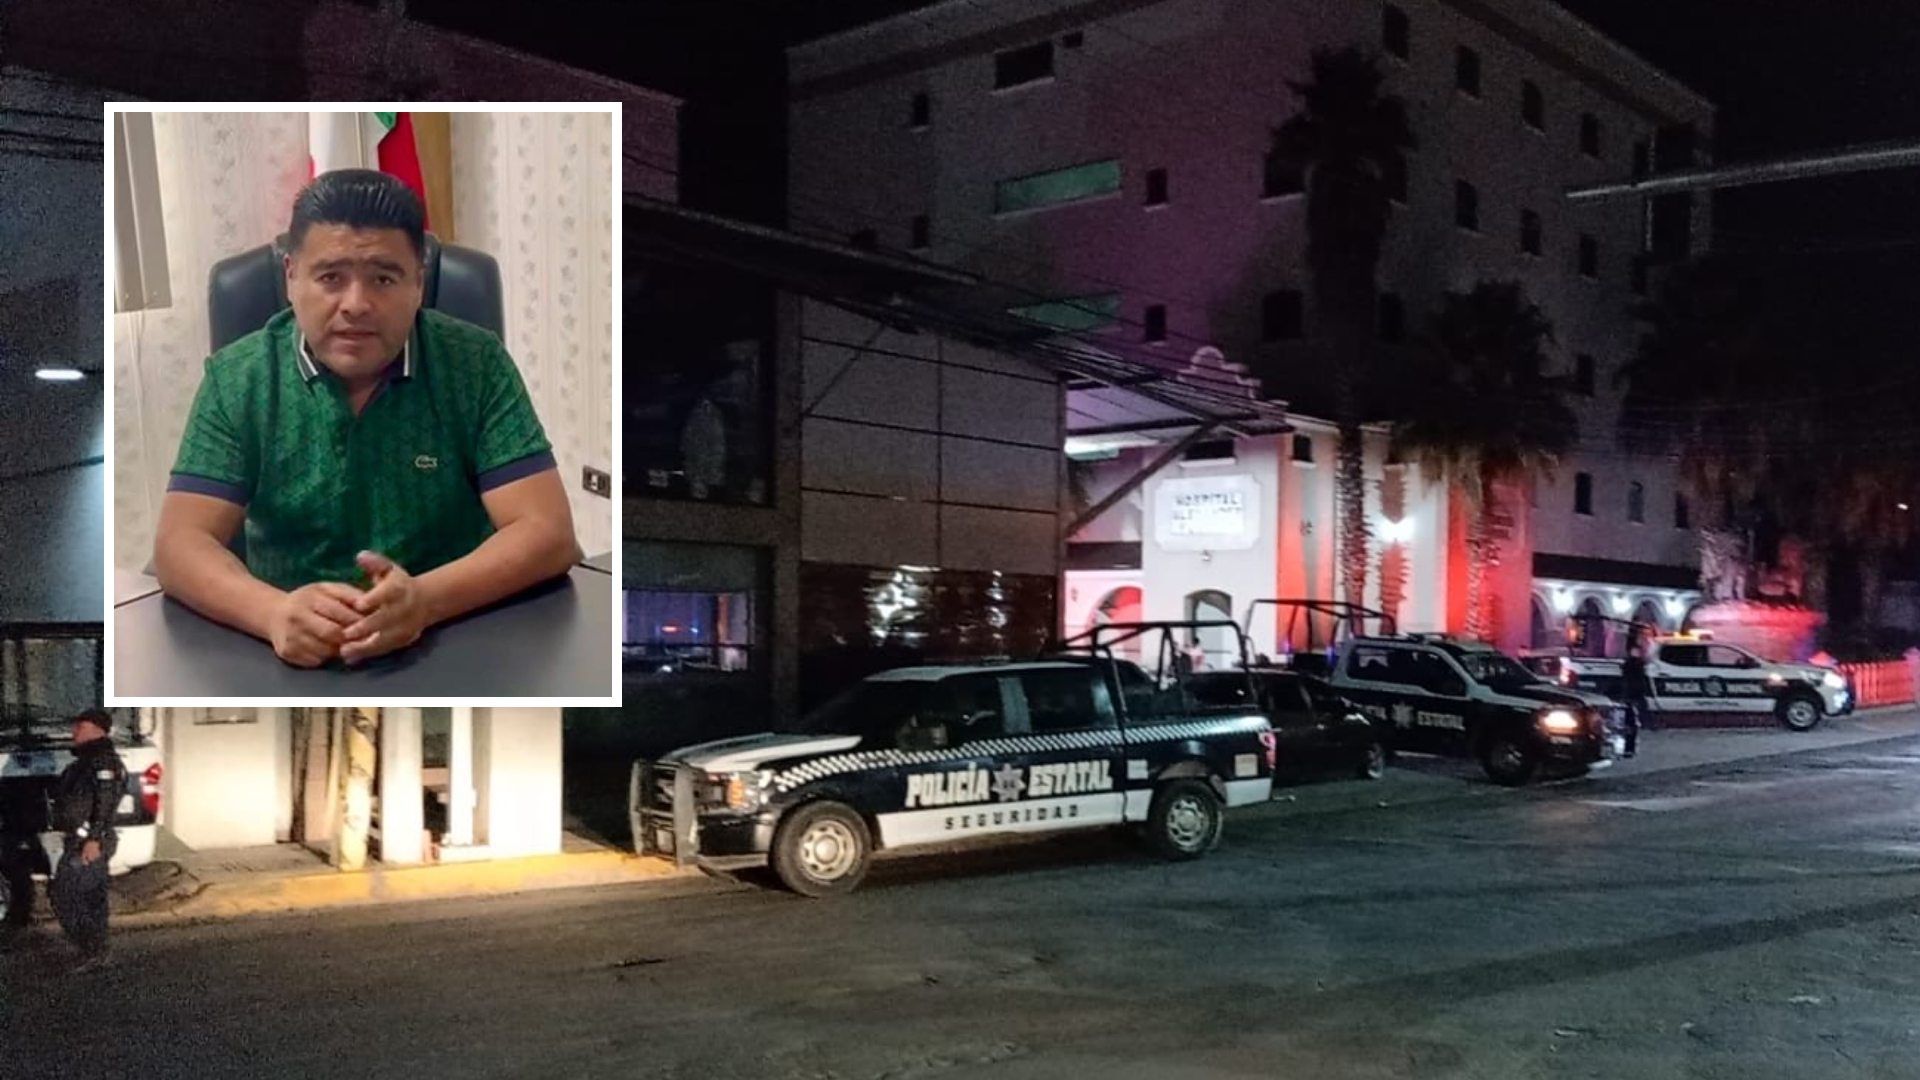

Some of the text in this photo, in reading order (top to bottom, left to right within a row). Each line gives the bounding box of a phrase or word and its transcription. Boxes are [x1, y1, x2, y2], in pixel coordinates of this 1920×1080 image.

[905, 761, 990, 807] POLICÍA
[1027, 760, 1114, 797] ESTATAL
[944, 804, 1079, 830] SEGURIDAD
